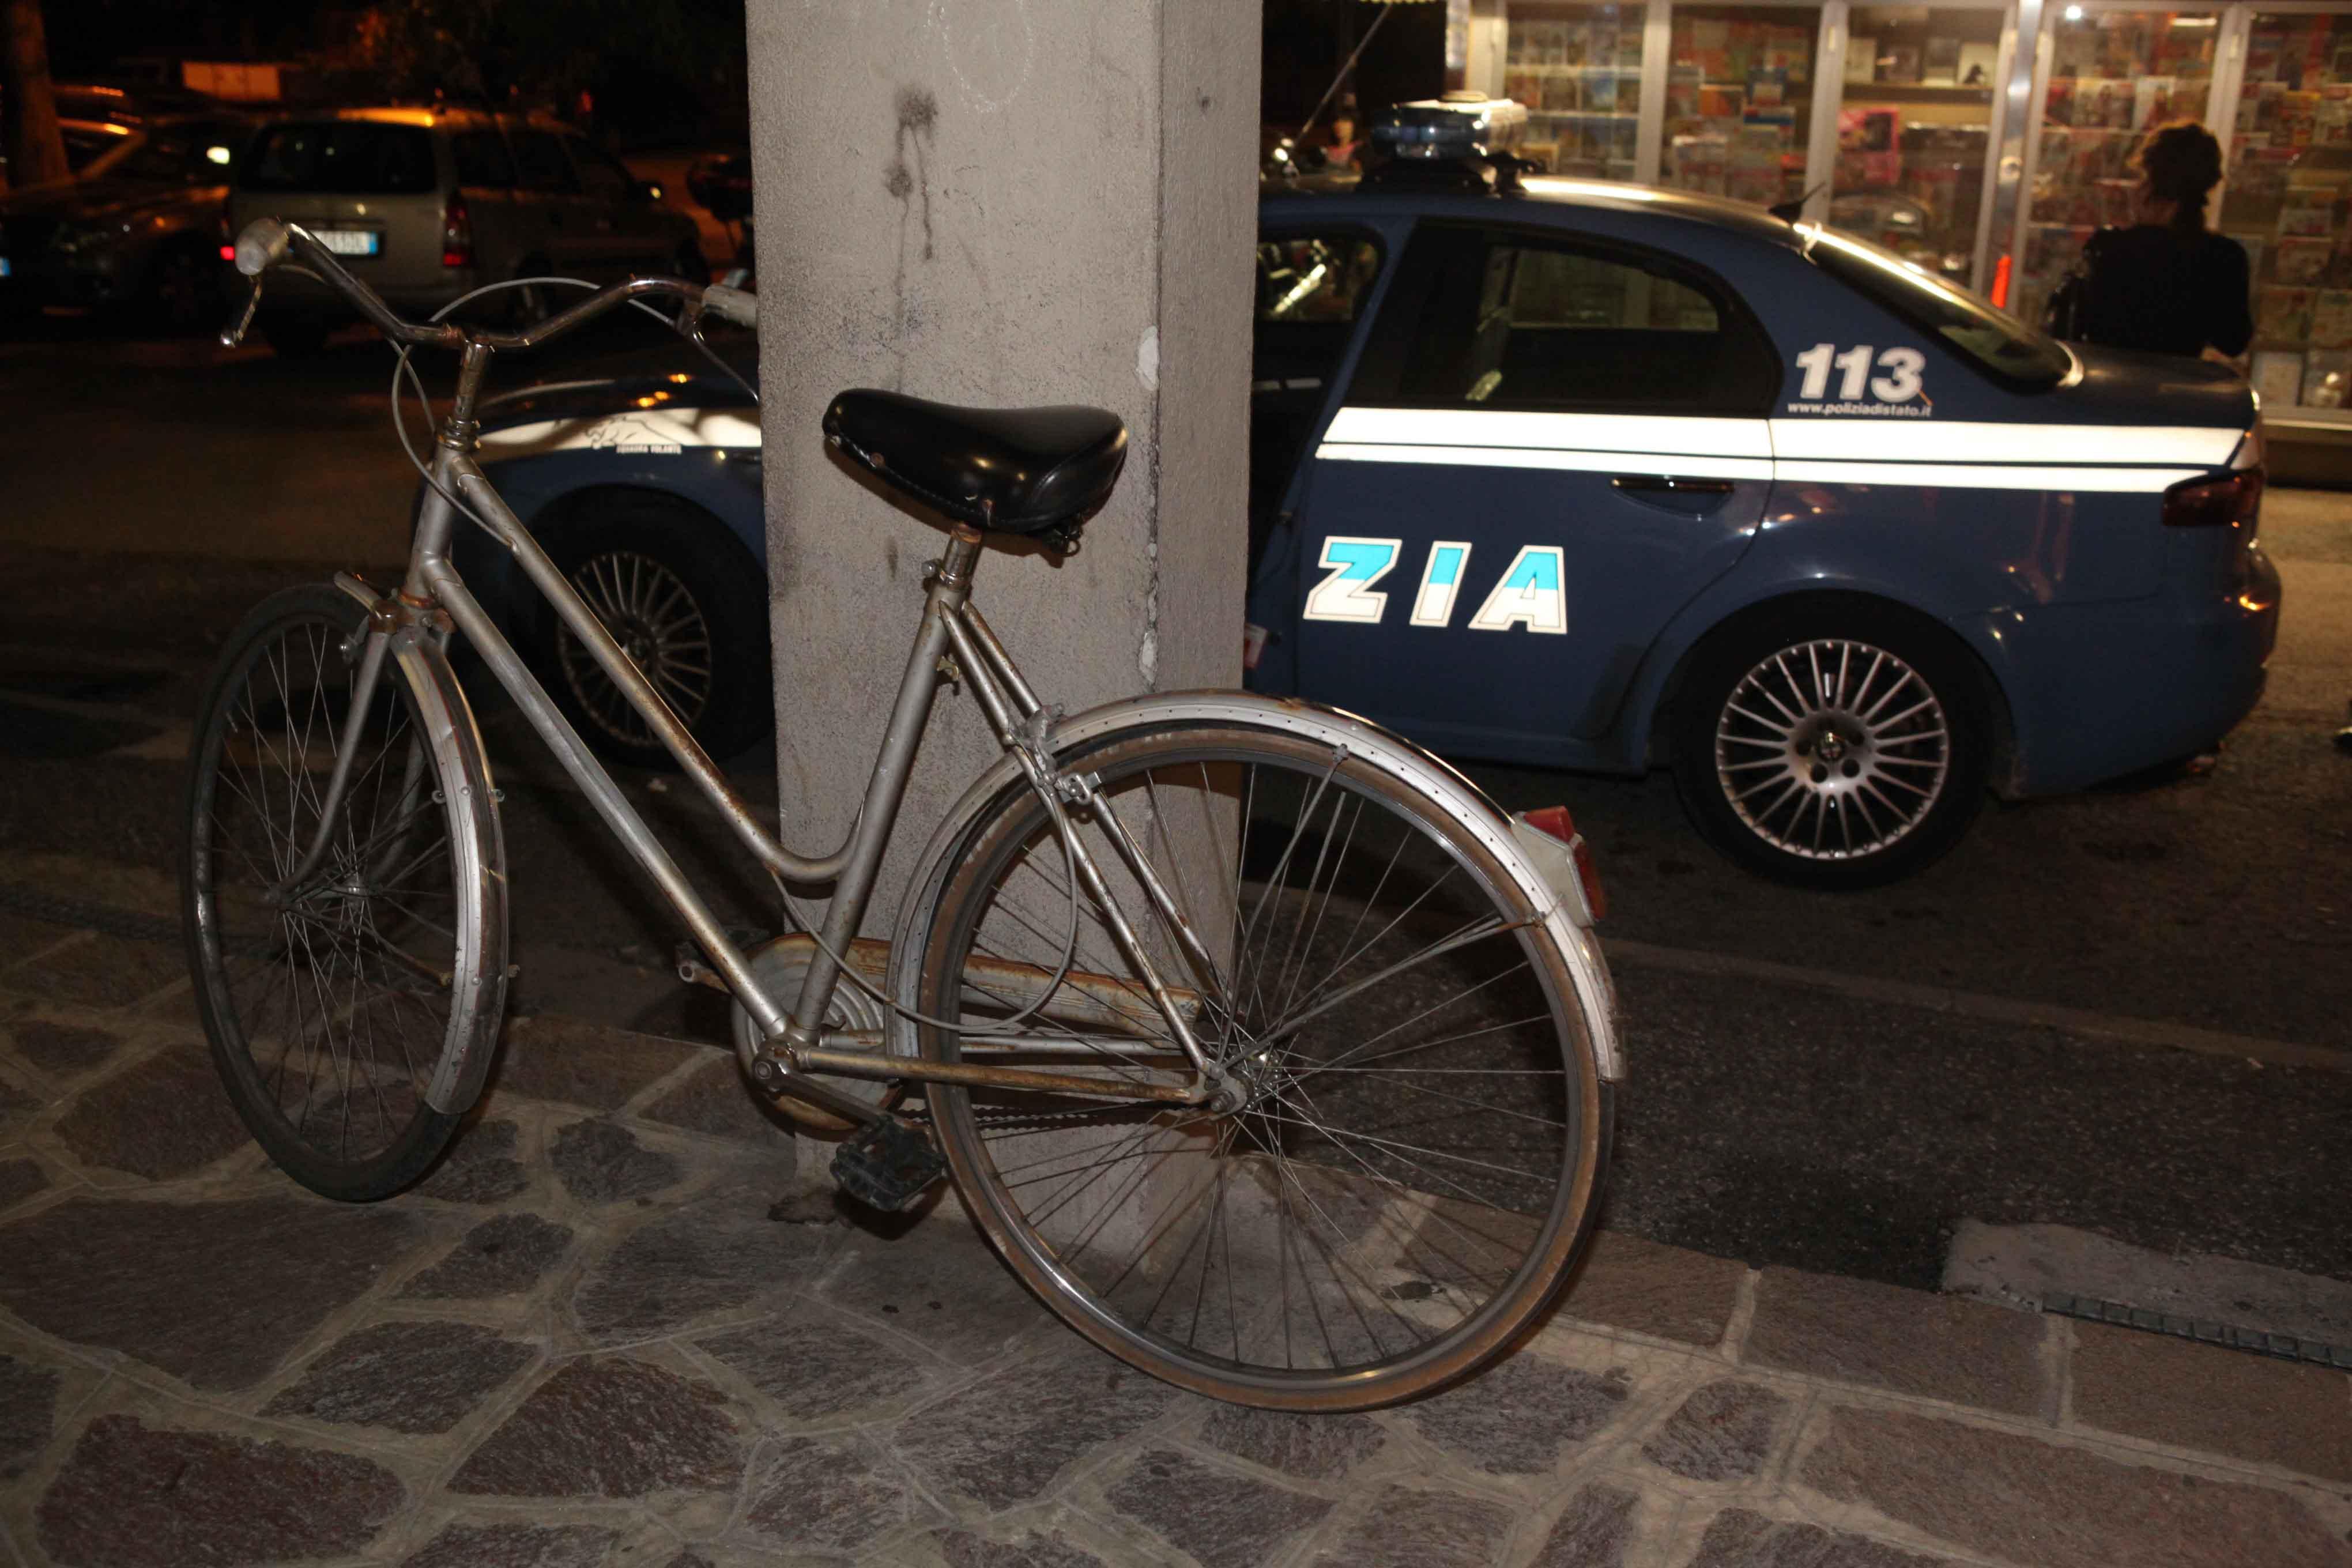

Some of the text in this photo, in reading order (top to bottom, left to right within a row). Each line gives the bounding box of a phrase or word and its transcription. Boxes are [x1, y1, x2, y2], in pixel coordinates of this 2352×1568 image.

[1796, 343, 1926, 402] 113
[1788, 402, 1931, 417] www.poliziadistato.it
[1303, 536, 1567, 634] ZIA
